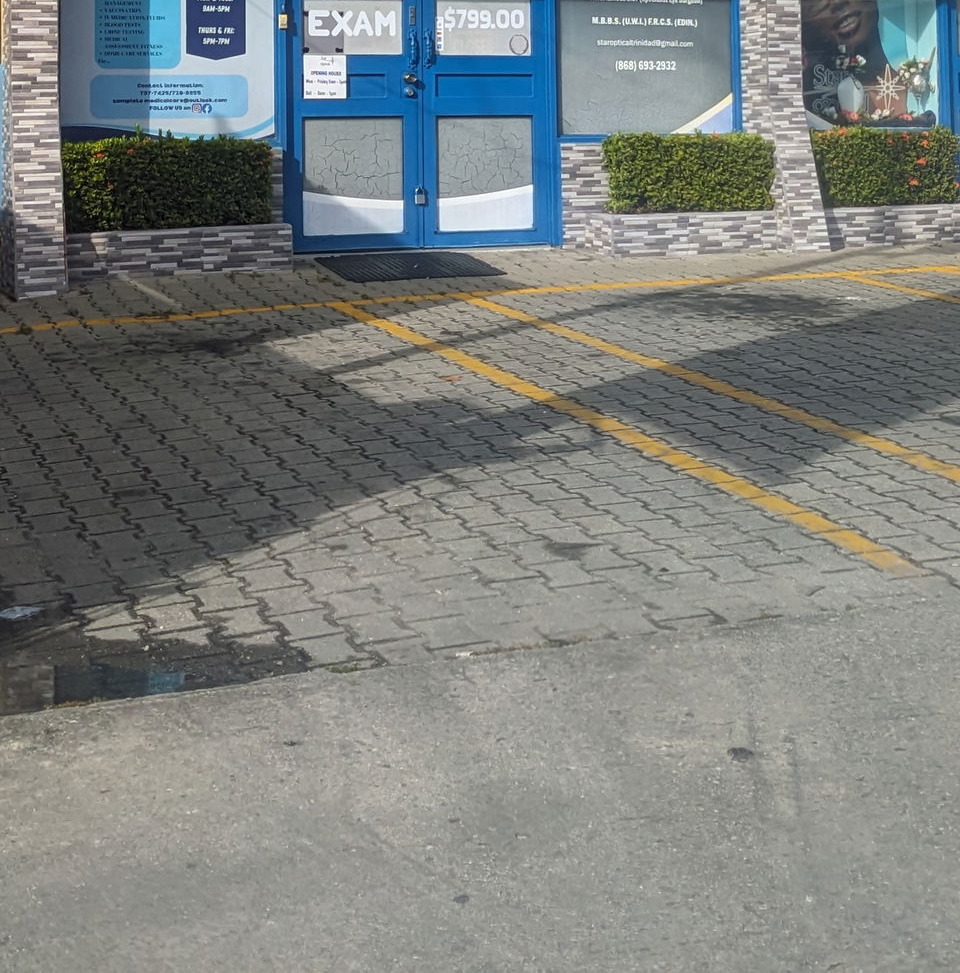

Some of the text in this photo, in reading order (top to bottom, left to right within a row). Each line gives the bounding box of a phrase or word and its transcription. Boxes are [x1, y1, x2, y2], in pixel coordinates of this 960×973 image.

[307, 6, 525, 37] EXAM $799.00
[592, 16, 622, 25] M.B.B.S.
[648, 18, 674, 27] F.R.C.S.
[596, 38, 694, 49] staropticaltrinidad@gmail.com
[615, 60, 677, 72] (868) 693-2932
